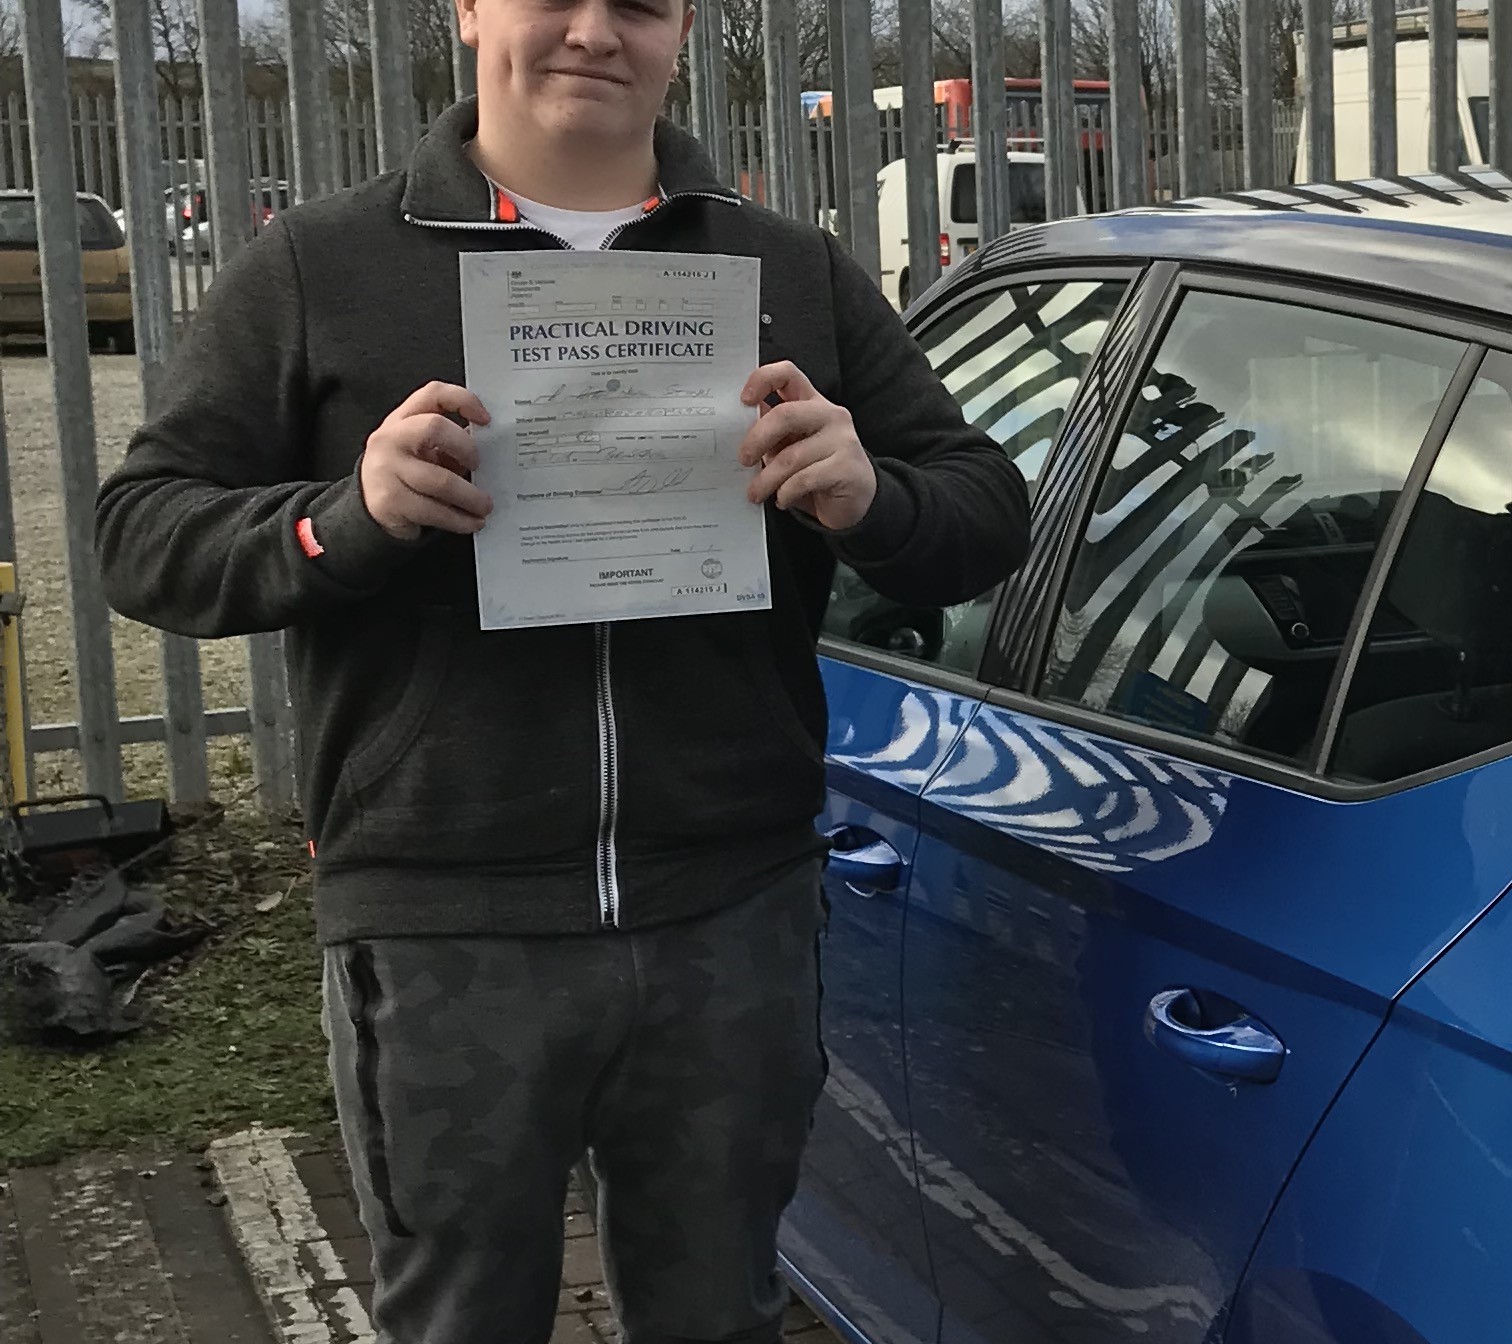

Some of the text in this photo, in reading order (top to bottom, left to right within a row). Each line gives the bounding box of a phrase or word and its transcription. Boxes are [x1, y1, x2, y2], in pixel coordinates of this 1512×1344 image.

[510, 320, 714, 341] PRACTICAL DRIVING
[511, 342, 714, 363] TEST PASS CERTIFICATE
[598, 568, 654, 580] IMPORTANT
